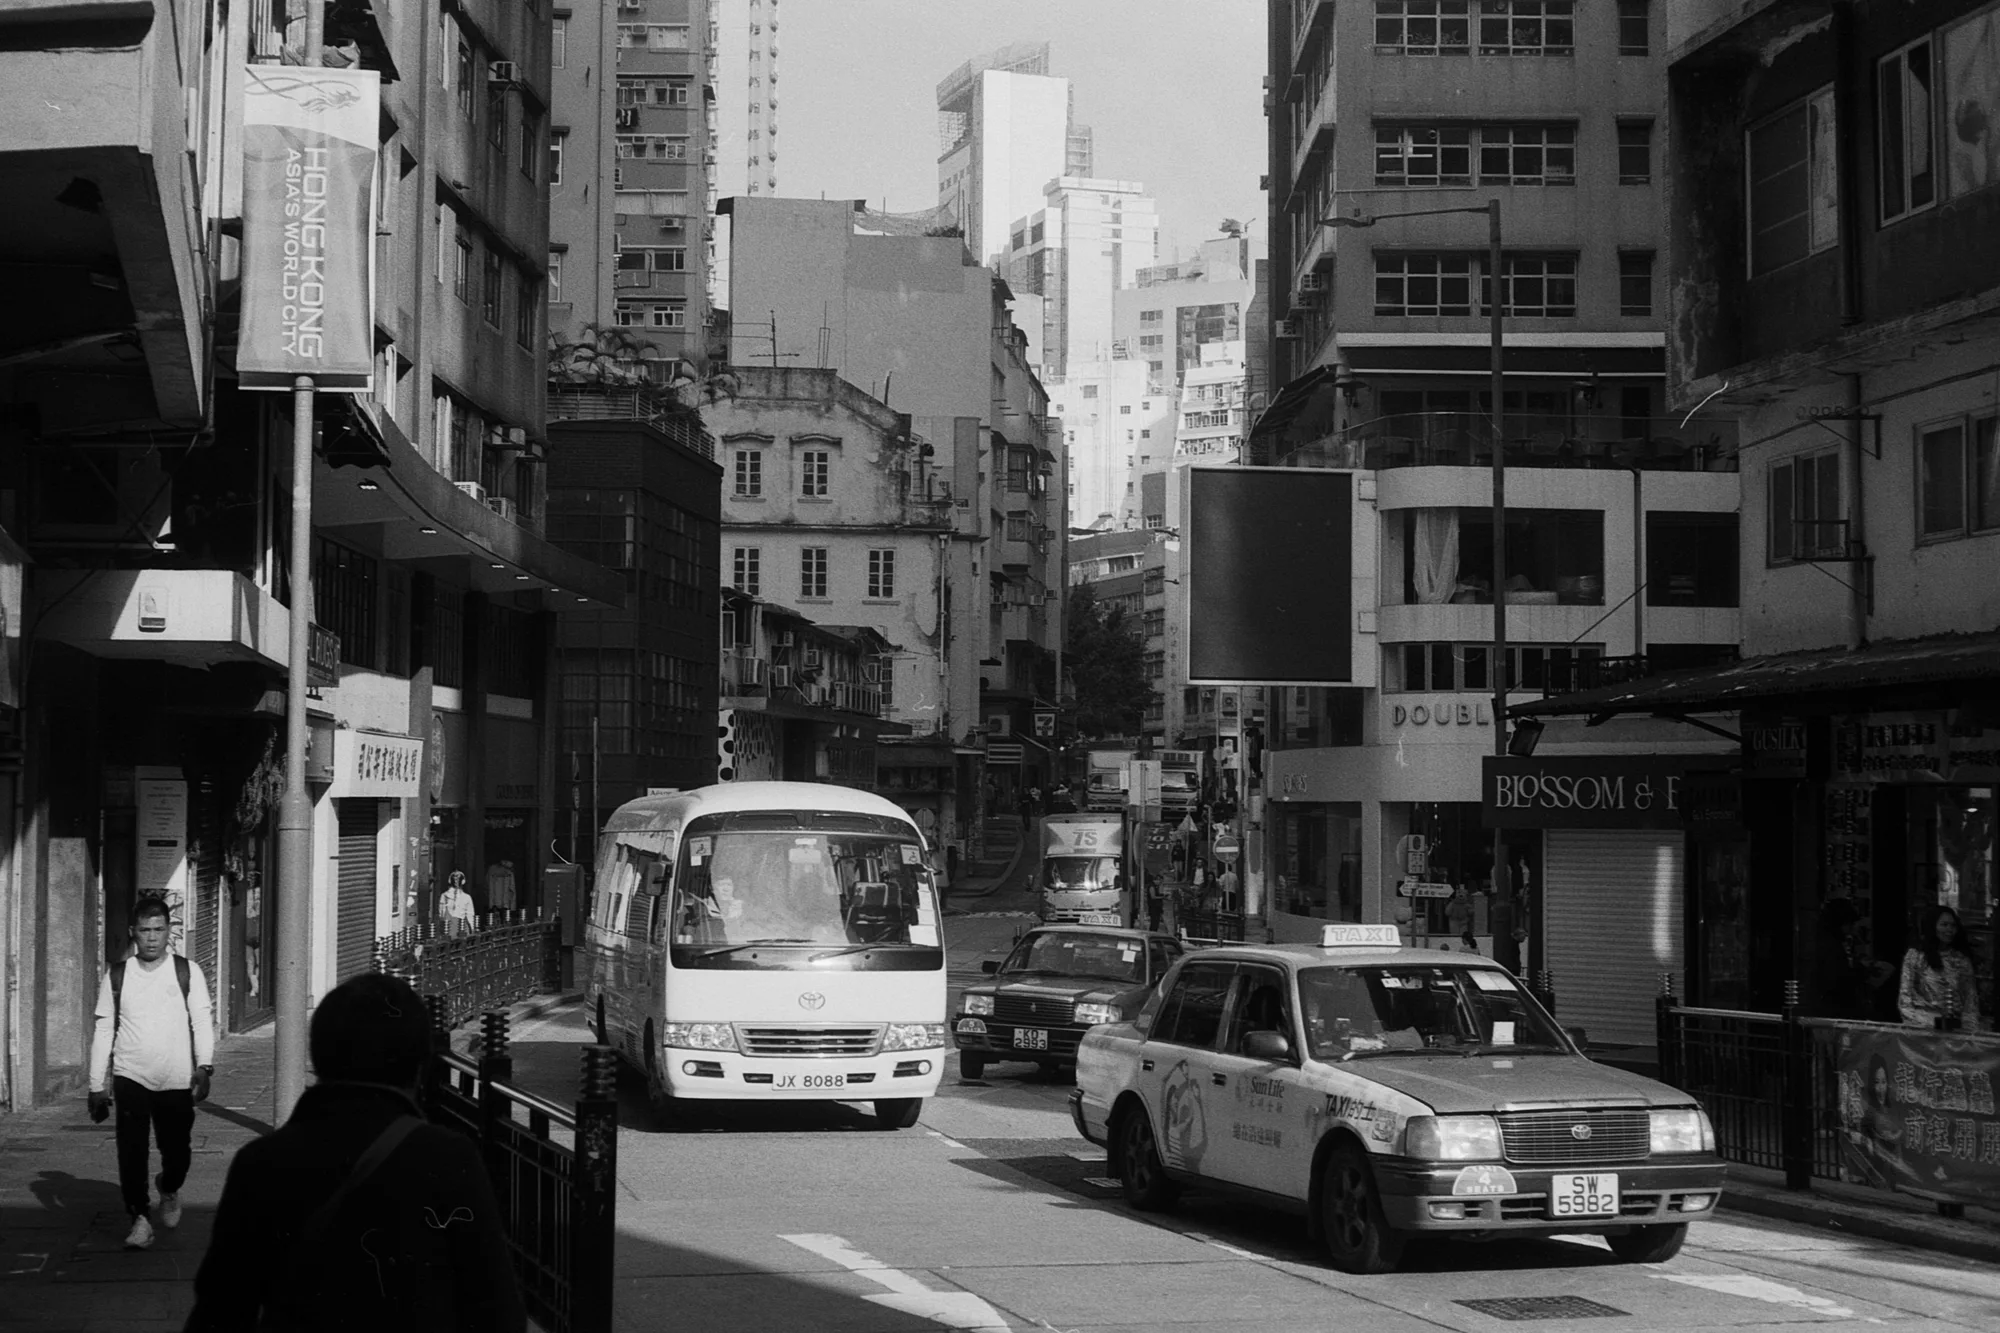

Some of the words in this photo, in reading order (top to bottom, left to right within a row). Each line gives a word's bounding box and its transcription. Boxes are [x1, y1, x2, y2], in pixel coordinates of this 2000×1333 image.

[284, 147, 302, 217] ASIA'S
[302, 147, 329, 249] HONG
[282, 221, 301, 301] WORLD
[298, 255, 325, 358] KONG
[281, 304, 299, 357] CITY
[1494, 770, 1626, 810] BLOSSOM
[1634, 775, 1654, 810] &
[1081, 914, 1119, 925] TAXI
[1331, 927, 1394, 942] TAXI
[1015, 1037, 1046, 1049] 2993
[776, 1075, 797, 1088] JX
[803, 1075, 844, 1088] 8088
[1250, 1075, 1267, 1096] Sun
[1267, 1078, 1285, 1099] Life
[1325, 1094, 1352, 1118] TAXI
[1479, 1171, 1491, 1185] 4
[1571, 1175, 1599, 1195] SW
[1558, 1194, 1615, 1214] 5982
